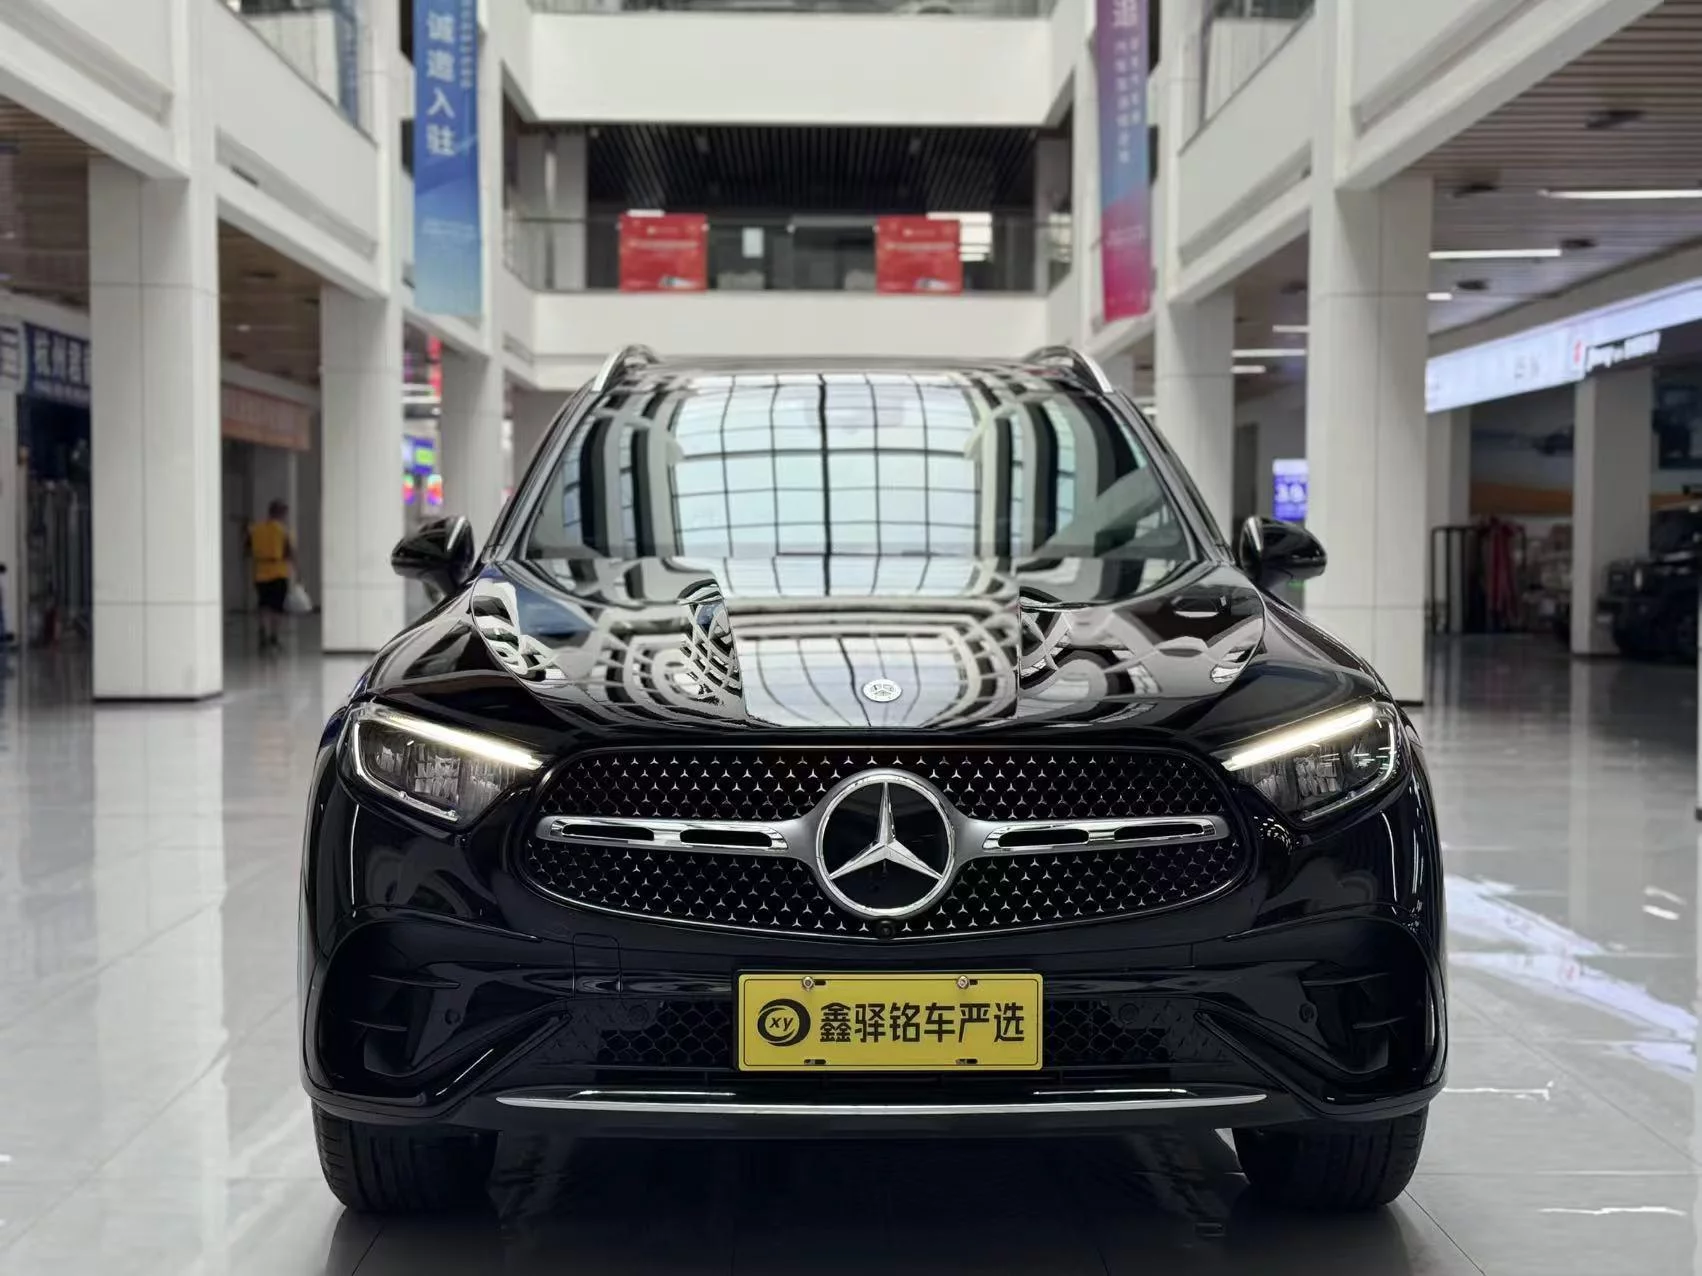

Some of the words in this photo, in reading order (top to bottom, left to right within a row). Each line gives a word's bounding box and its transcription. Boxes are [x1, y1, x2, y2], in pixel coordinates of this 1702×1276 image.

[426, 10, 455, 156] 诚邀入驻
[819, 1002, 1025, 1043] 鑫驿铭车严选
